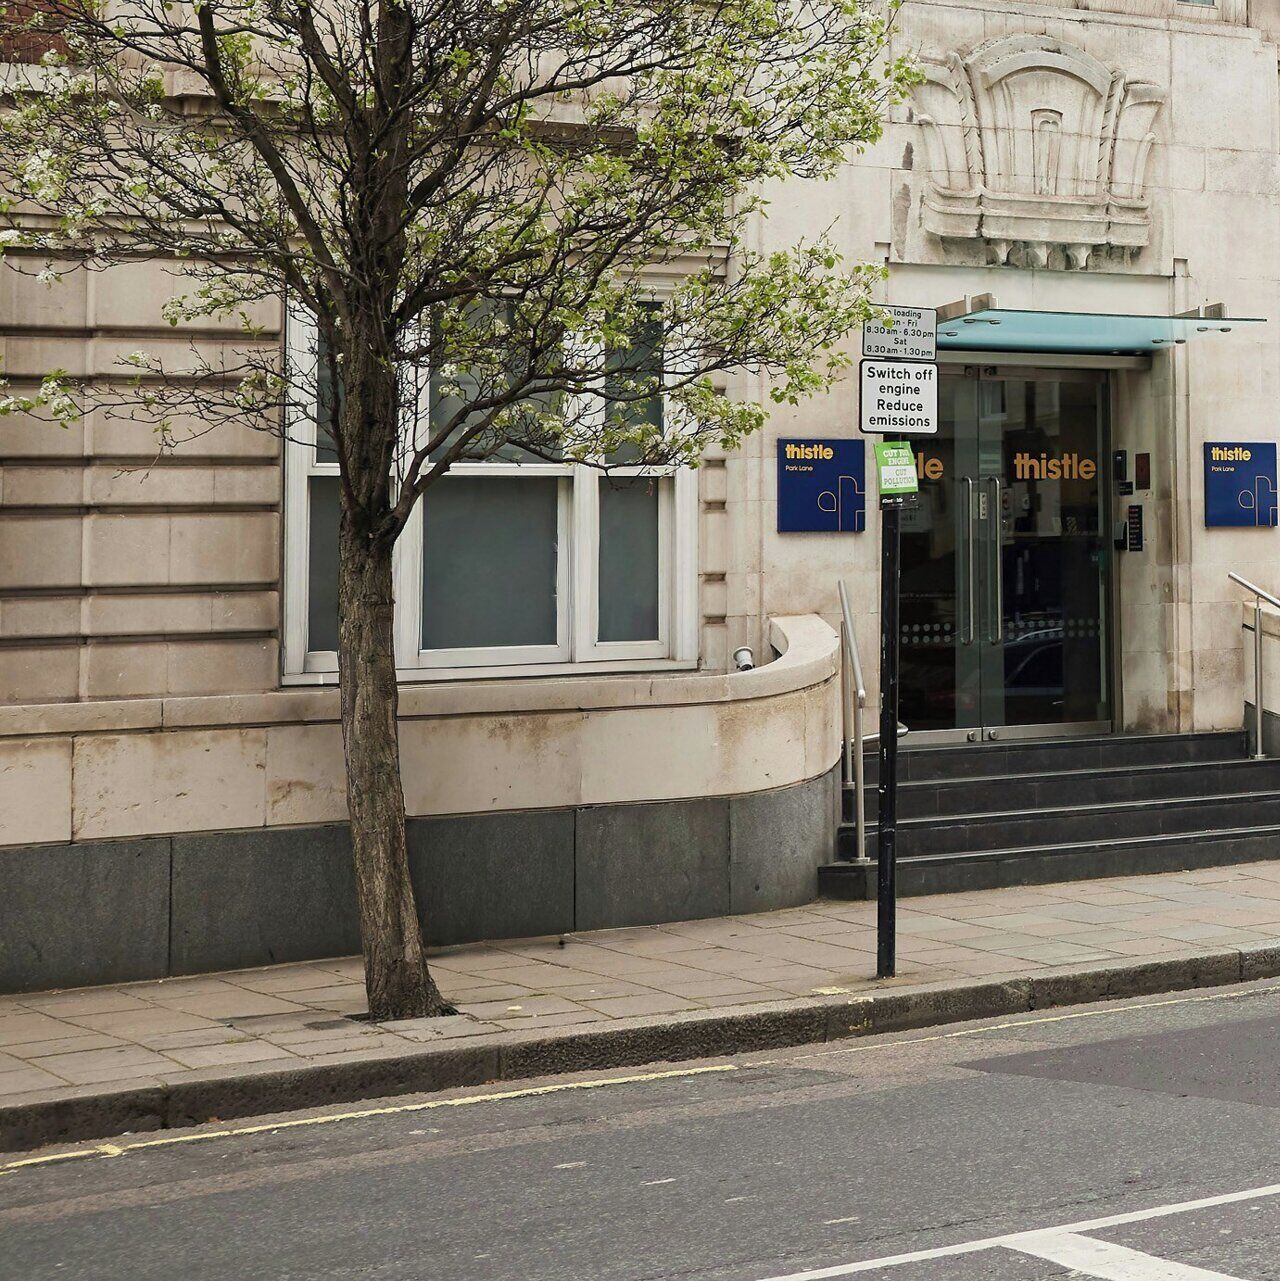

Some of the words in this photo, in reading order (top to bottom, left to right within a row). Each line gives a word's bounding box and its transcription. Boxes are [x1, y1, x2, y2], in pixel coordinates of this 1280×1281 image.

[894, 309, 922, 319] loading
[867, 326, 885, 334] 8.30
[867, 366, 910, 379] Switch
[915, 369, 933, 380] off
[879, 383, 920, 396] engine
[877, 399, 923, 412] Reduce
[869, 415, 930, 427] emissions
[785, 444, 834, 459] thistle
[1211, 447, 1251, 462] thistle
[1014, 453, 1096, 480] thistle
